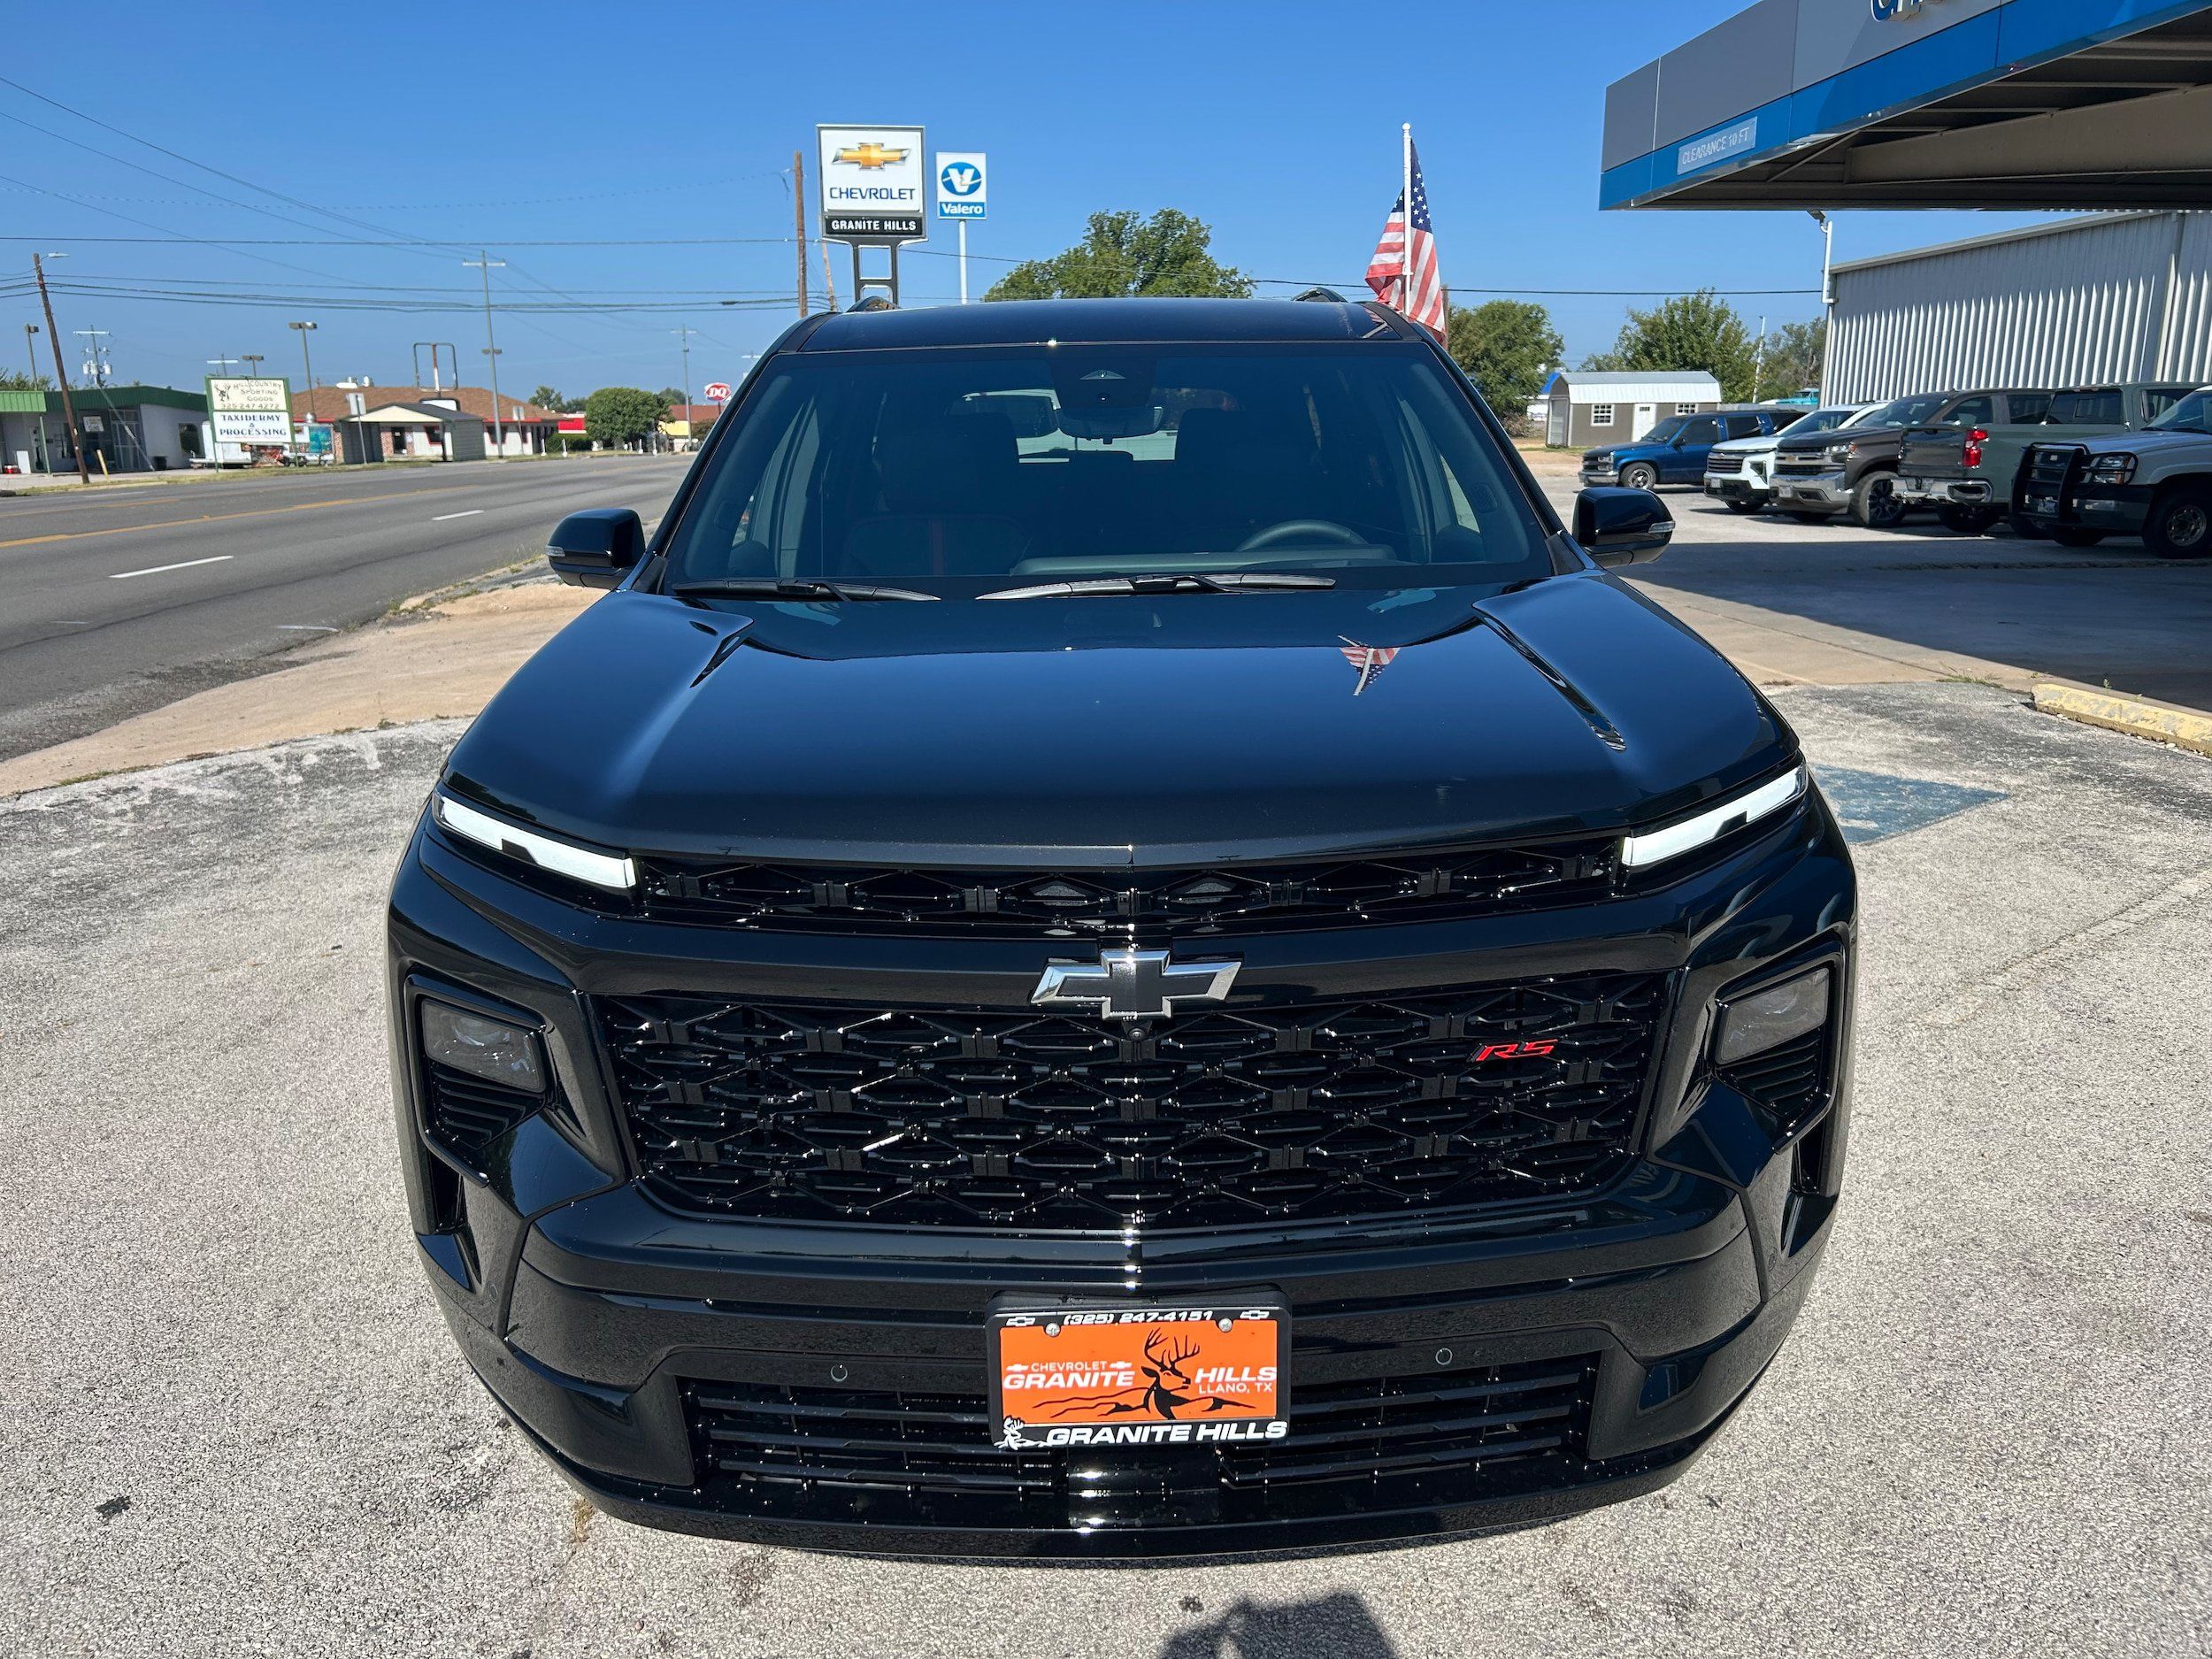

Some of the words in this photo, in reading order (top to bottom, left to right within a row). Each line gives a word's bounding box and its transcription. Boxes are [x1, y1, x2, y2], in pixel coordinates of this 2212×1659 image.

[1682, 135, 1727, 165] CLEARANCE
[1729, 133, 1737, 148] 10
[1739, 127, 1749, 144] FT
[829, 187, 916, 201] CHEVROLET
[941, 203, 983, 216] Valero
[831, 219, 880, 231] GRANITE
[884, 219, 917, 232] HILLS
[709, 387, 726, 397] DQ
[1475, 1038, 1558, 1062] RS
[1063, 1313, 1115, 1325] (325)
[1031, 1360, 1106, 1372] CHEVROLET
[1003, 1370, 1135, 1390] GRANITE
[1194, 1366, 1278, 1384] HILLS
[1198, 1382, 1251, 1394] LLANO,
[1256, 1381, 1272, 1393] TX
[1046, 1424, 1194, 1446] GRANITE
[1197, 1420, 1288, 1441] HILLS
